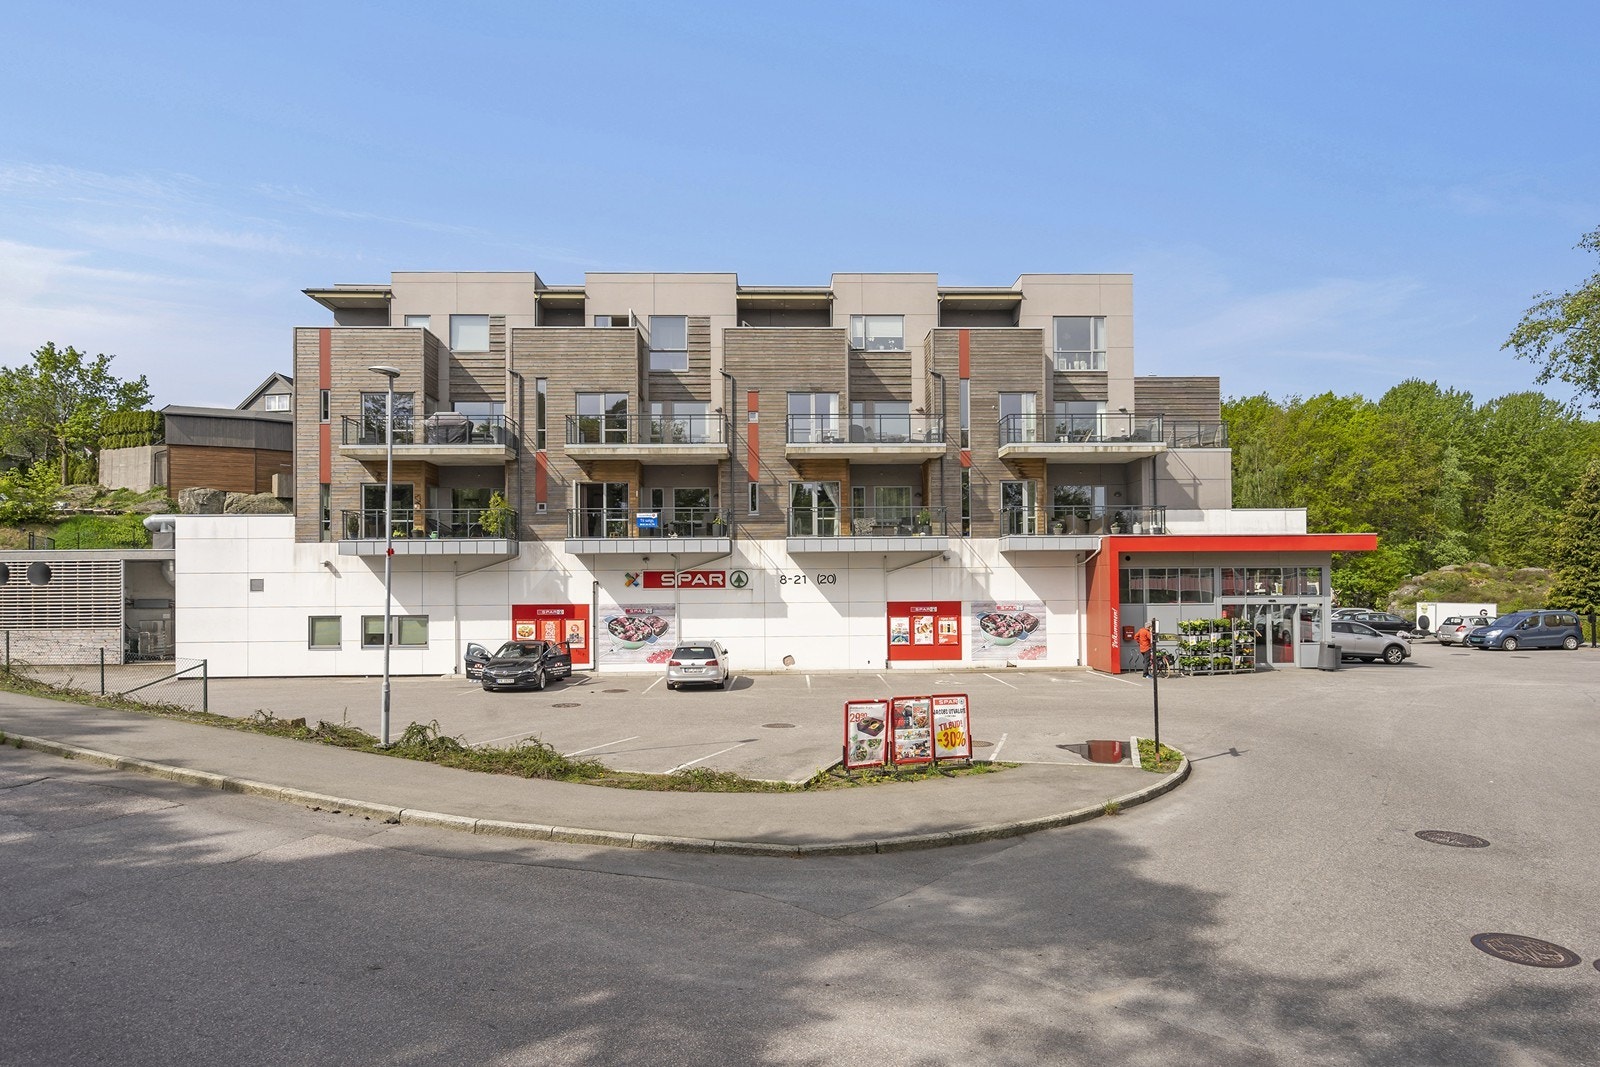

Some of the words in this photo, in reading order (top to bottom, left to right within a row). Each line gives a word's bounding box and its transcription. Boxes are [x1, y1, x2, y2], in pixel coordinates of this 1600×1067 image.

[661, 574, 723, 586] SPAR
[779, 574, 807, 585] 8-21
[816, 573, 837, 585] (20)
[1111, 607, 1119, 648] Velkommen!
[938, 720, 963, 732] TILBUD!
[937, 731, 966, 748] -30%
